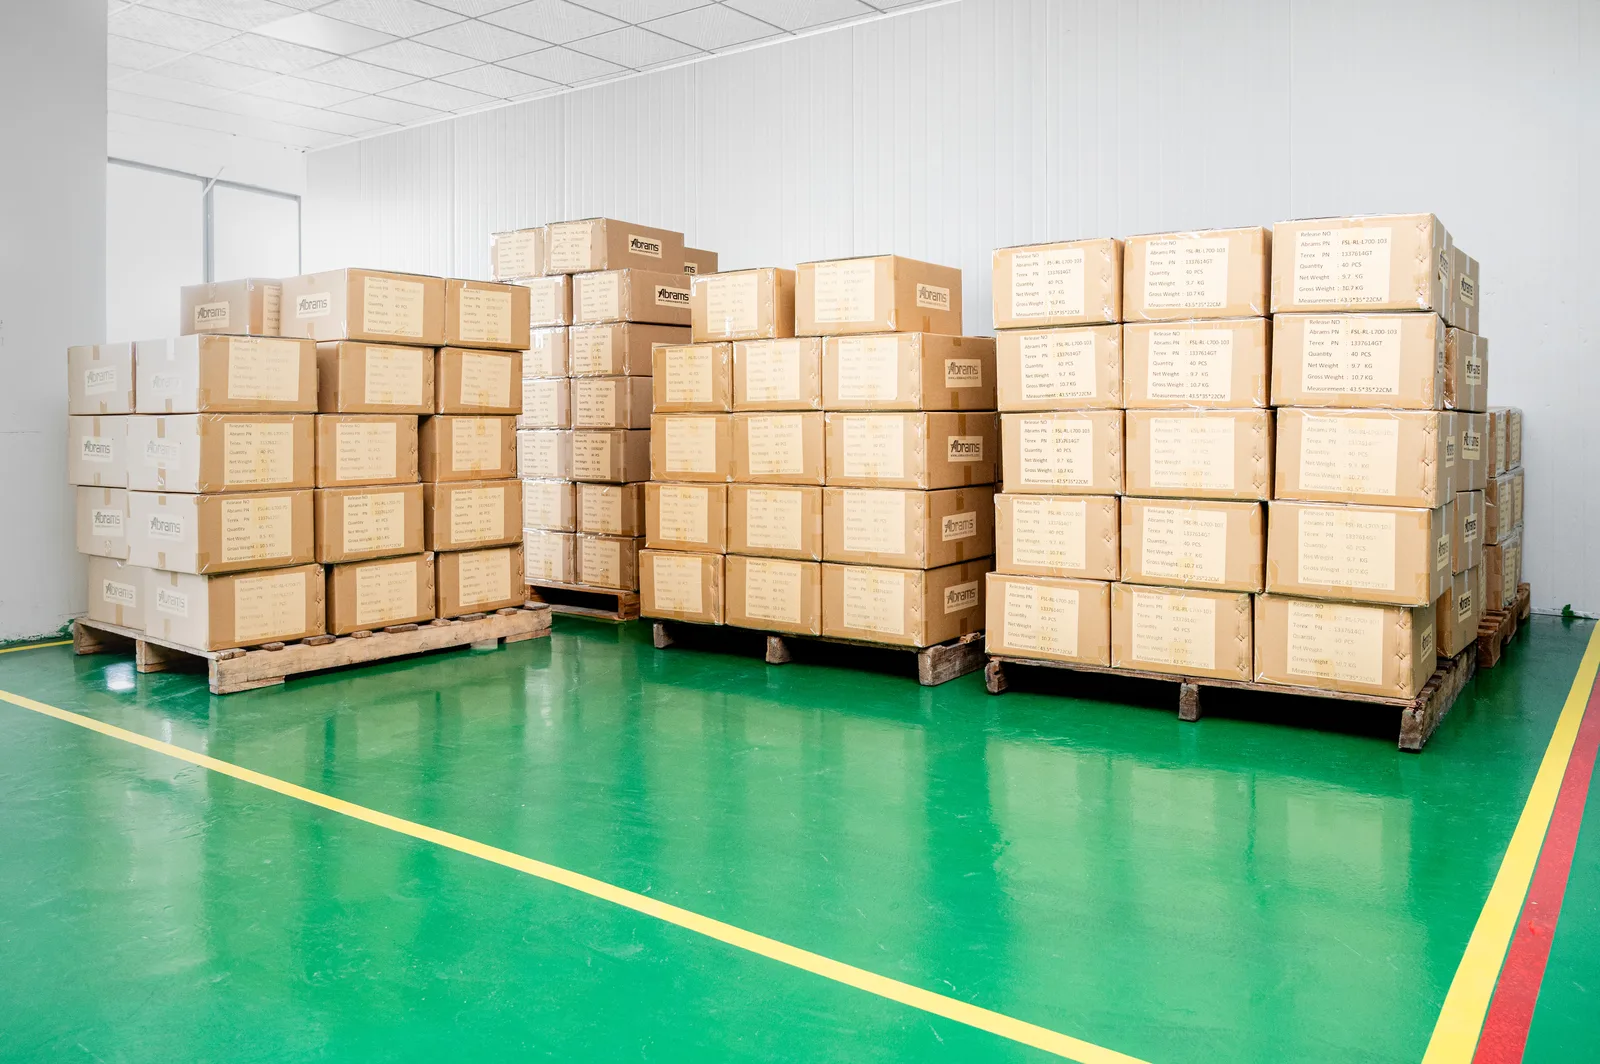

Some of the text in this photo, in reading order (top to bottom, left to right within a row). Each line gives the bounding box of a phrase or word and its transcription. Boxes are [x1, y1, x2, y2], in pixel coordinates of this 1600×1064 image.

[630, 238, 659, 252] Abrams
[658, 288, 690, 301] Abrams
[919, 286, 947, 303] Abrams
[298, 298, 331, 311] Abrams
[197, 306, 227, 319] Abrams
[948, 361, 979, 375] Abrams
[87, 370, 115, 384] Abrams
[84, 440, 110, 454] Abrams
[950, 439, 980, 453] Abrams
[94, 511, 120, 525] Abrams
[150, 516, 181, 533] Abrams
[944, 519, 974, 533] Abrams
[105, 582, 134, 600] Abrams
[946, 588, 976, 605] Abrams
